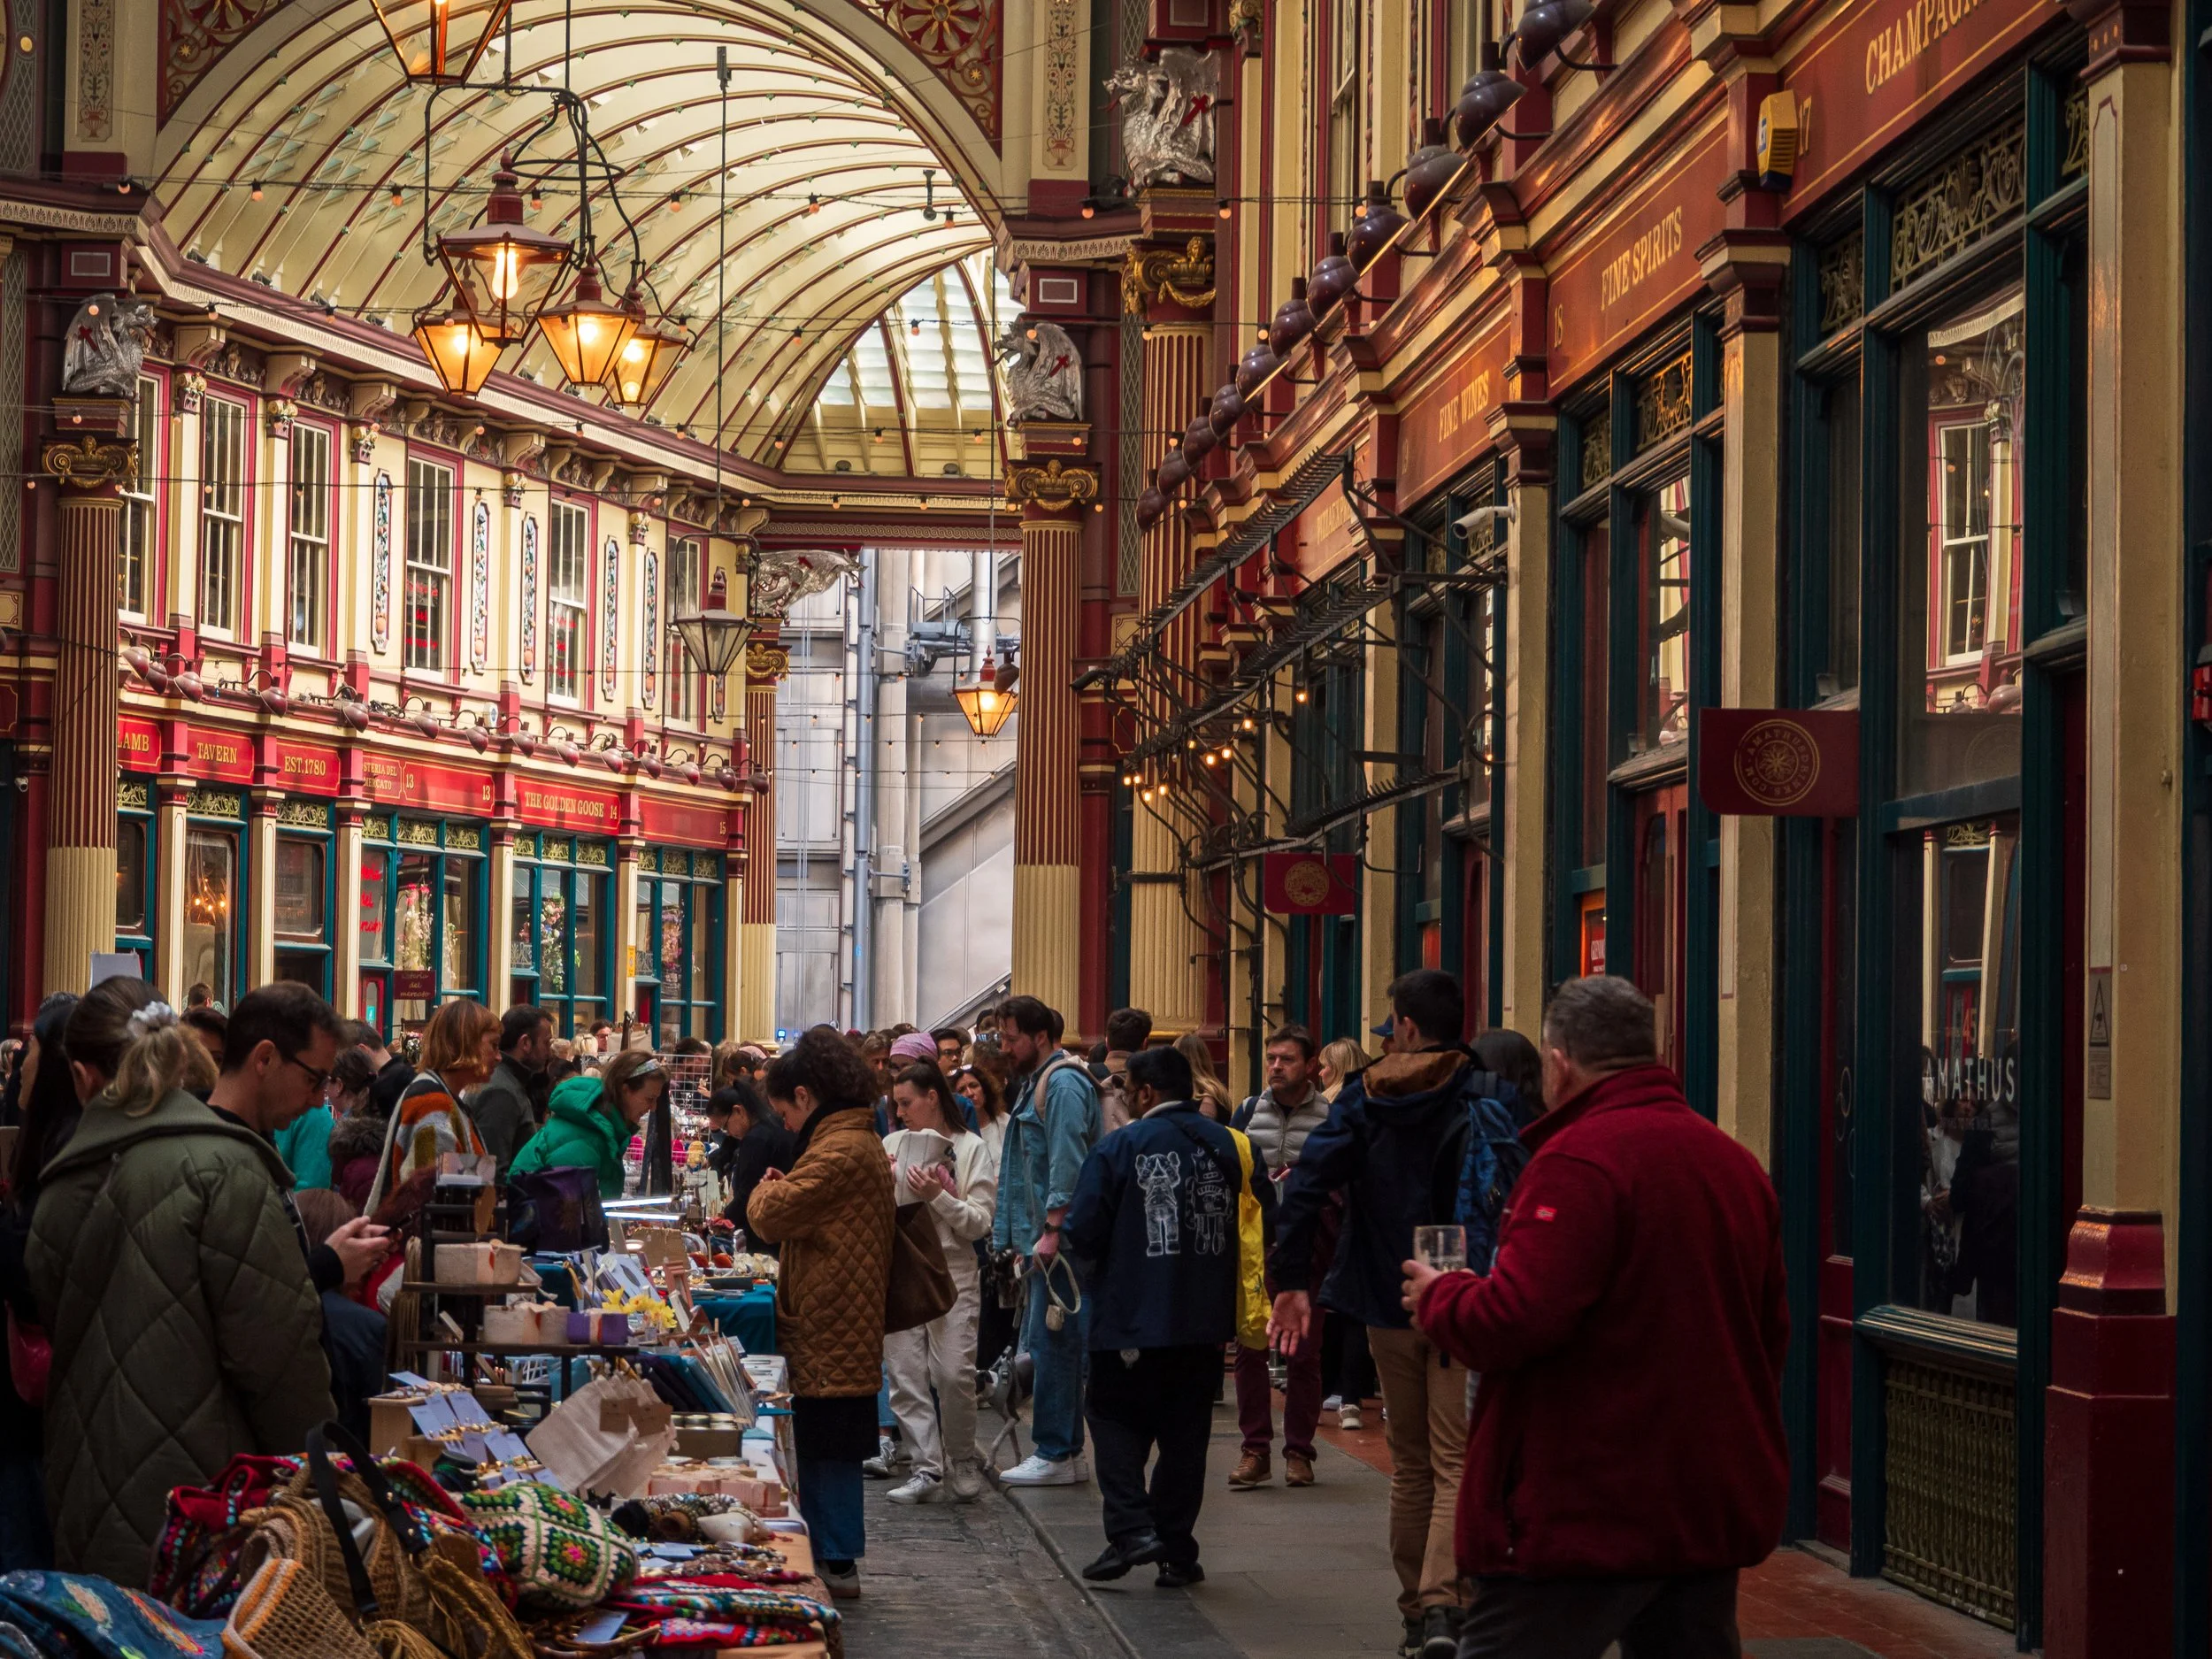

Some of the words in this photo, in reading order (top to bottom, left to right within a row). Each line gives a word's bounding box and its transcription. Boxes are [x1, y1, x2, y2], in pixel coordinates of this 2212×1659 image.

[1798, 96, 1812, 157] 17
[1601, 250, 1630, 311] FINE
[1632, 205, 1682, 286] SPIRITS
[1554, 303, 1563, 348] 18
[1439, 395, 1459, 443] FINE
[1461, 369, 1489, 425] WINES
[196, 741, 238, 764] TAVERN
[284, 756, 326, 776] EST.1780
[386, 765, 398, 777] DEL
[406, 773, 414, 788] 13
[482, 785, 491, 801] 13
[525, 791, 541, 808] THE
[543, 795, 576, 813] GOLDEN
[577, 799, 604, 818] GOOSE
[610, 806, 618, 819] 14
[719, 822, 726, 834] 15
[1923, 1057, 2016, 1102] AMATHUS
